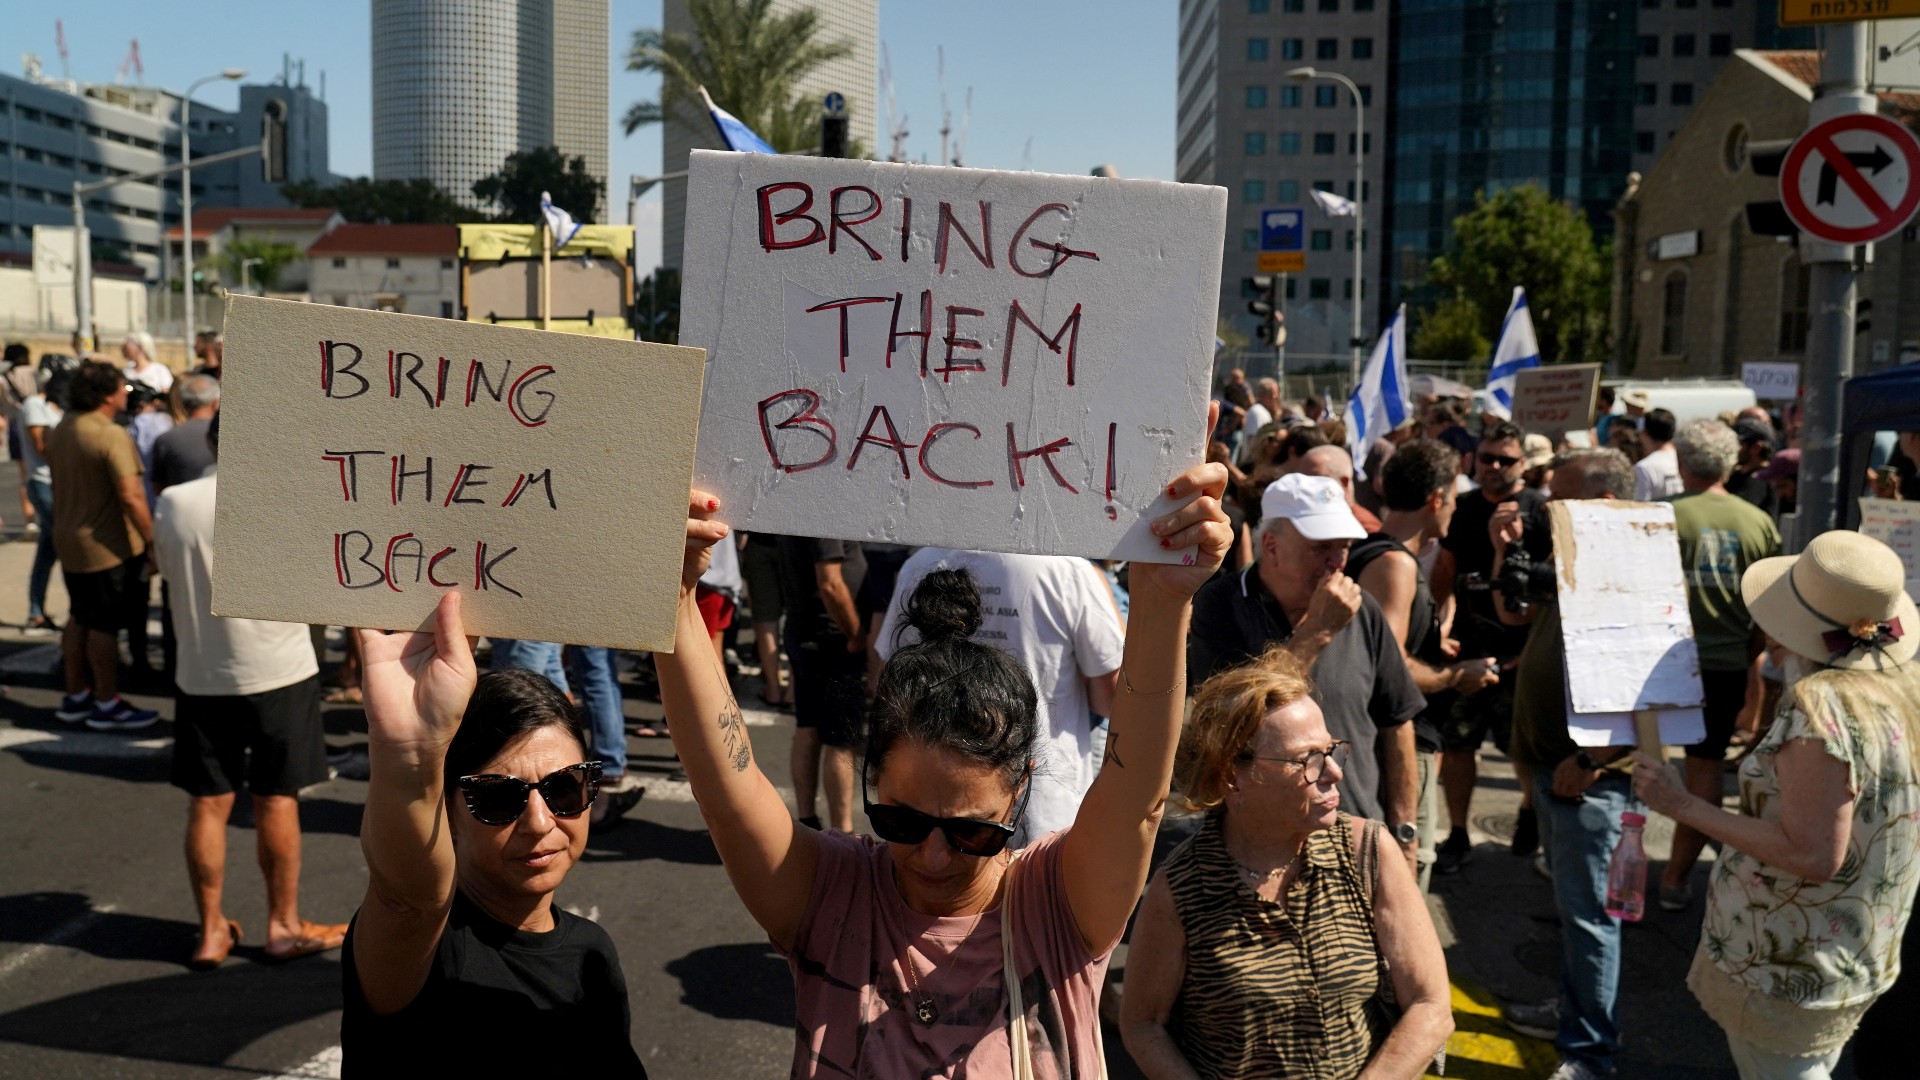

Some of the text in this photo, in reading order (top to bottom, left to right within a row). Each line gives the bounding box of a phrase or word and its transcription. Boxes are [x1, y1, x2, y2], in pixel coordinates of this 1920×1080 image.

[757, 181, 1099, 278] BRING
[806, 289, 1082, 387] THEM
[318, 340, 556, 427] BRING
[322, 449, 557, 510] THEM
[757, 388, 1117, 521] BACK!
[333, 530, 523, 598] BACK
[997, 607, 1019, 617] ASIA
